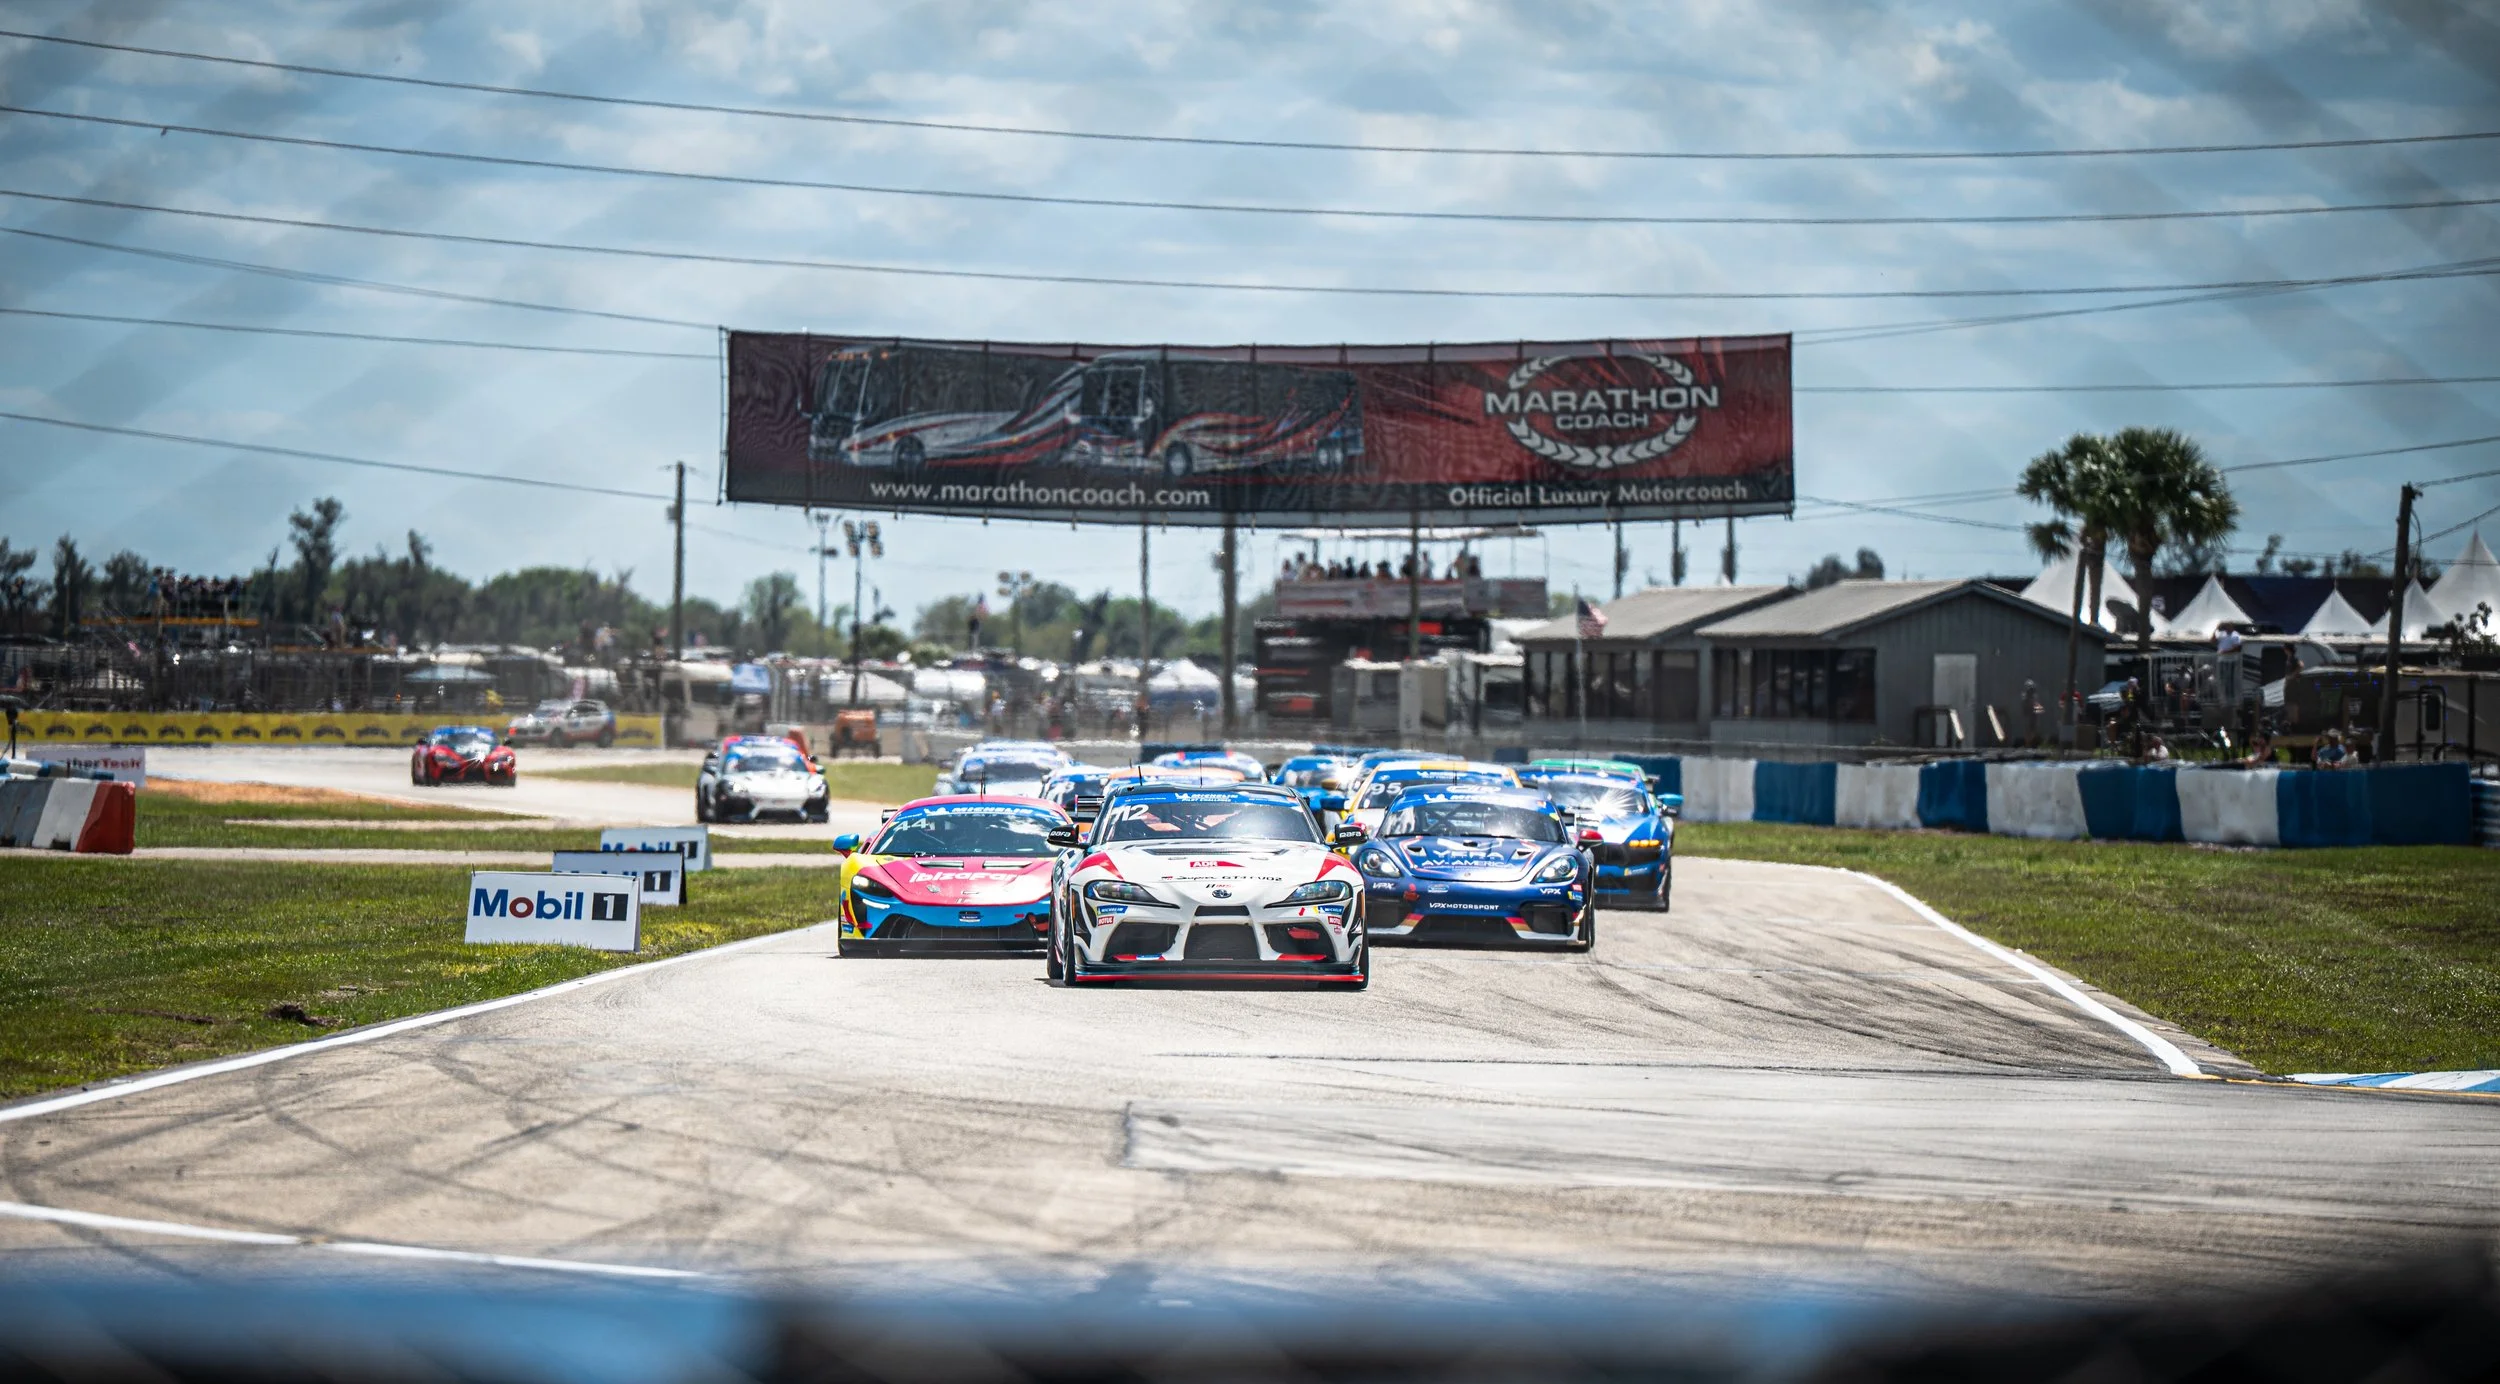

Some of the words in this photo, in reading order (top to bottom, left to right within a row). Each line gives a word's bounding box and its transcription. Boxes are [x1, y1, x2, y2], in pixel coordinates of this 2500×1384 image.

[1485, 386, 1719, 413] MARATHON
[1556, 412, 1649, 430] COACH
[870, 480, 1210, 505] www.marathoncoach.com
[1449, 487, 1531, 506] Official
[1539, 486, 1611, 508] Luxury
[1618, 481, 1748, 502] Motorcoach
[1370, 782, 1402, 795] 95
[1193, 860, 1218, 868] ADR
[1372, 881, 1394, 890] VPX
[1539, 887, 1562, 896] VPX
[472, 887, 584, 920] Mobil
